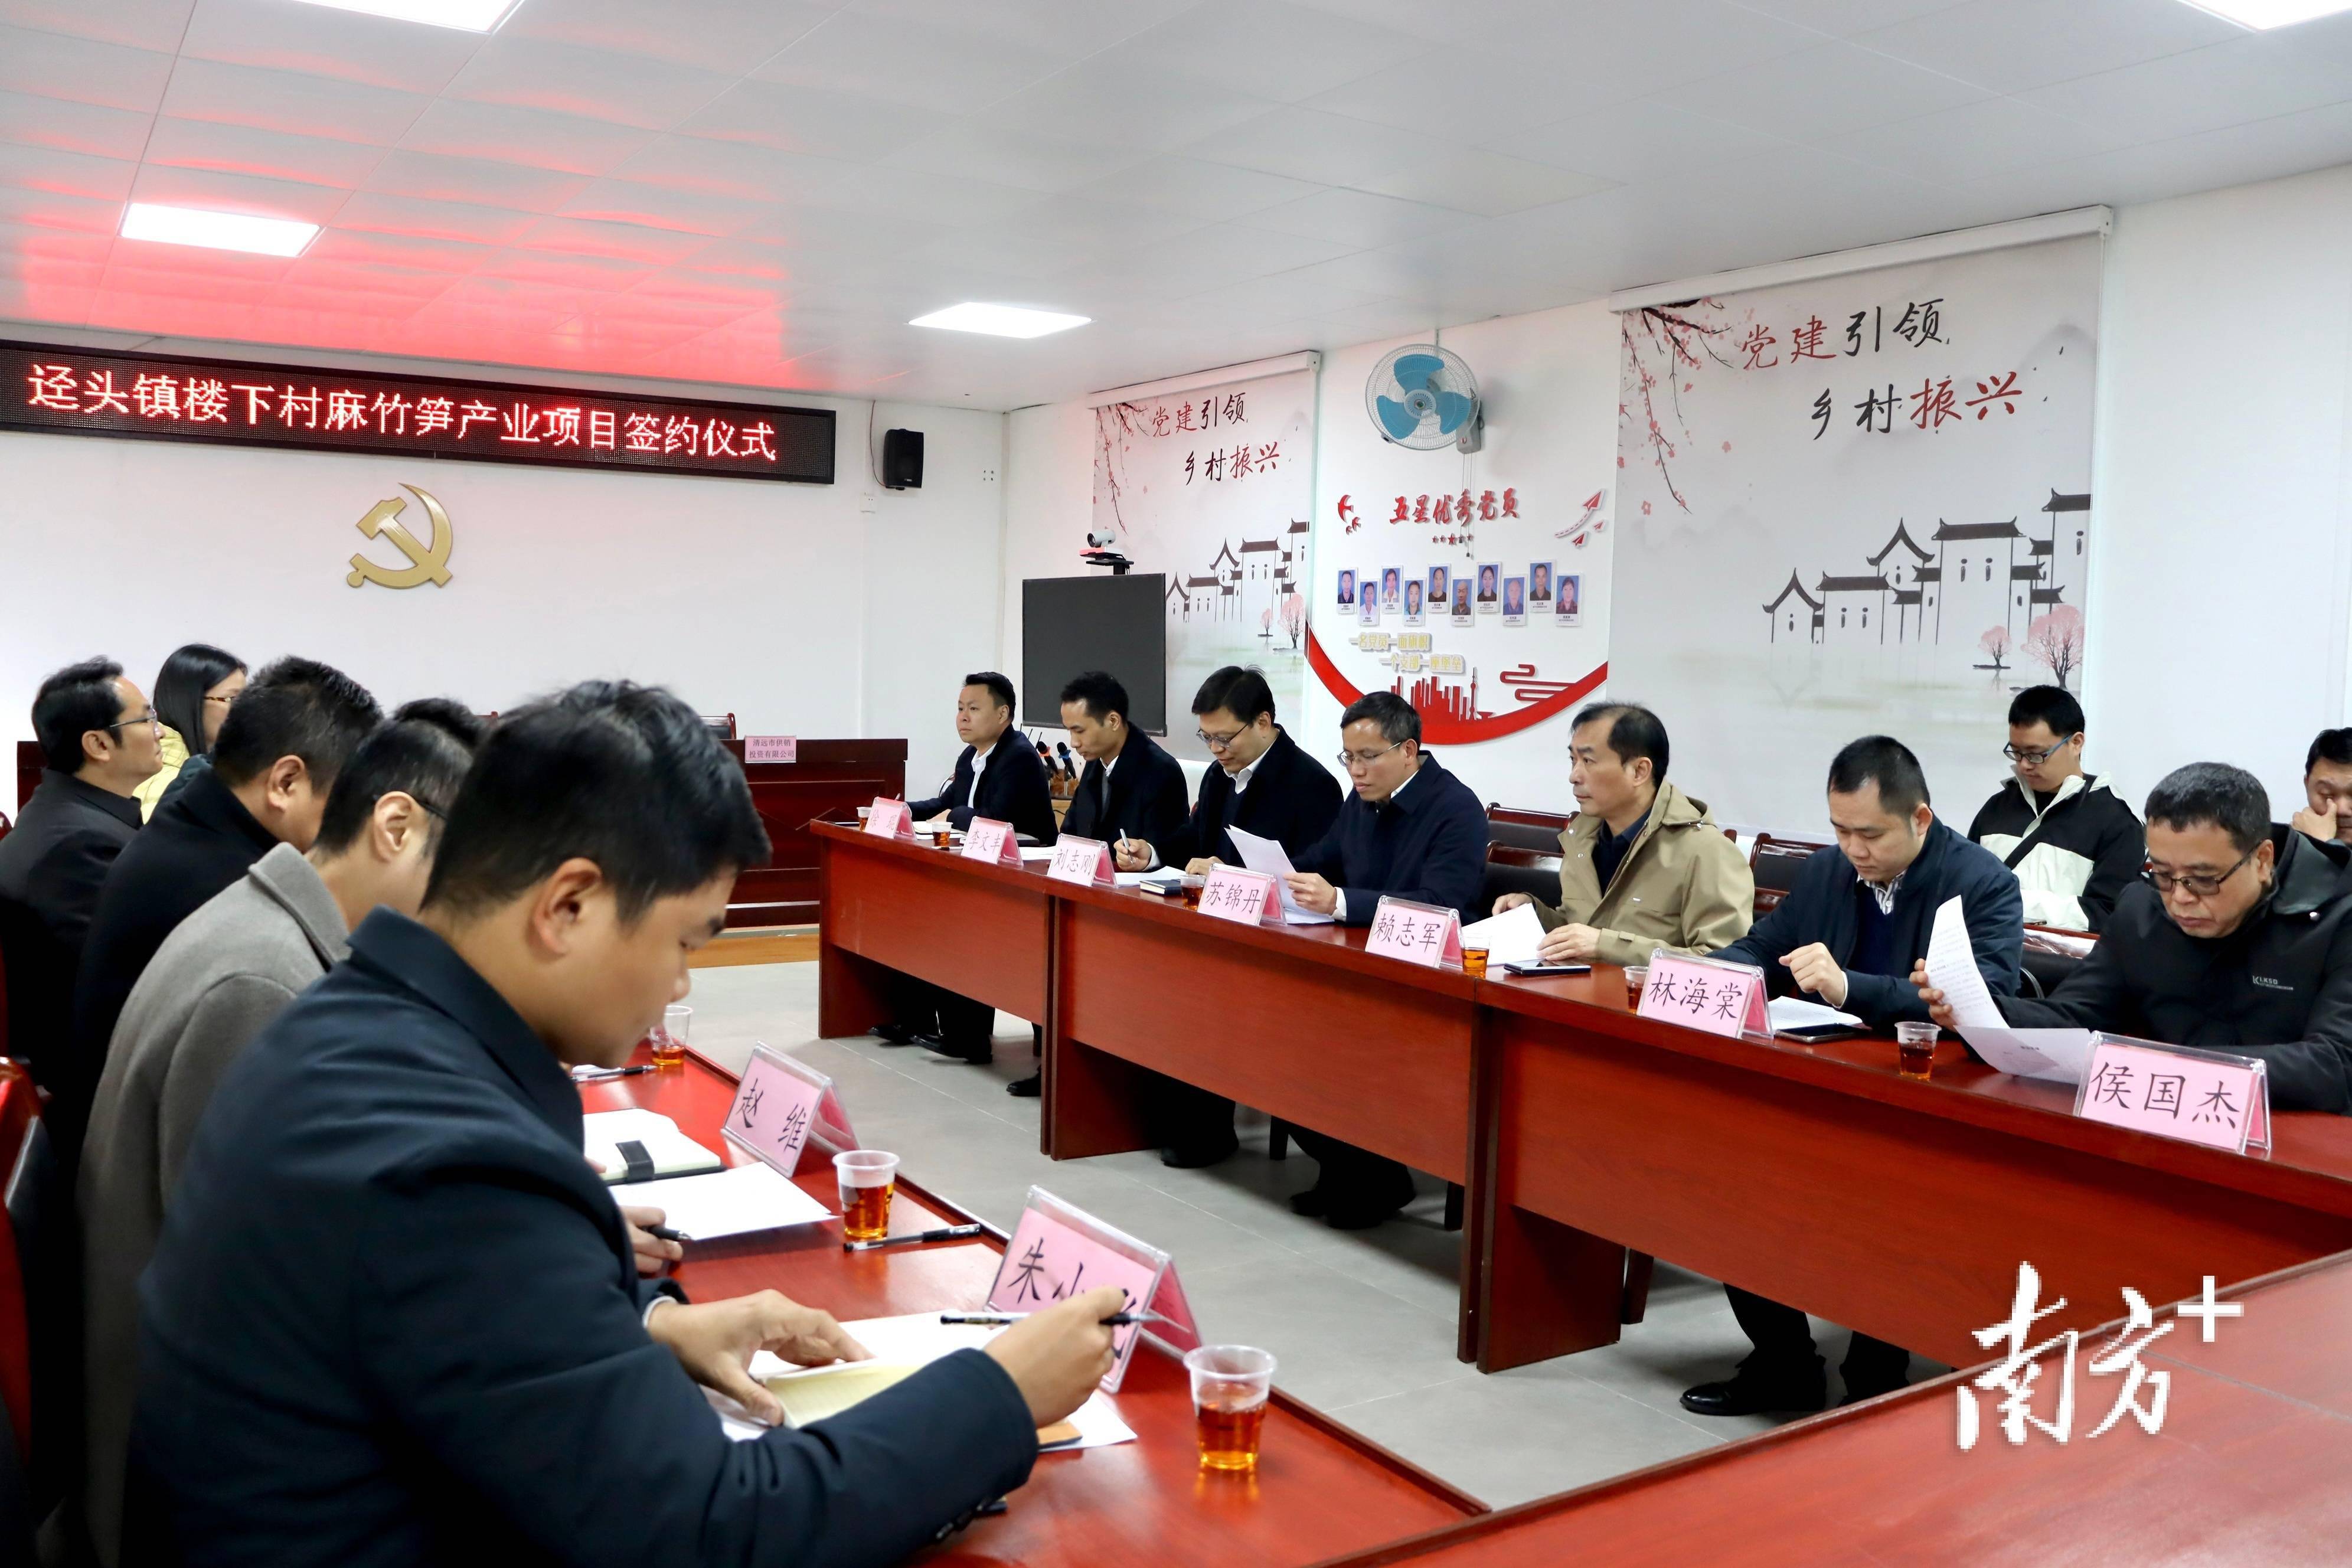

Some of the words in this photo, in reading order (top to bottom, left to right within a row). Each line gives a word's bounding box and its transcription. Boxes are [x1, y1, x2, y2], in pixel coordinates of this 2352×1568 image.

[1742, 298, 1945, 370] 党建引领
[27, 362, 777, 462] 迳头镇楼下村麻竹笋产业项目签约仪式
[1152, 391, 1248, 437] 党建引领
[1812, 371, 2023, 441] 乡村振兴
[1185, 440, 1280, 486] 乡村振兴
[1389, 487, 1521, 527] 五星优秀党员
[749, 749, 795, 759] 投资有限公司
[752, 738, 792, 747] 清远市供销
[968, 828, 1001, 854] 李文丰
[1053, 848, 1096, 877] 刘志刚
[1204, 880, 1262, 915] 苏锦丹
[1373, 912, 1442, 953] 赖志军
[1647, 971, 1743, 1021] 林海棠
[735, 1077, 806, 1153] 赵维
[2090, 1060, 2241, 1129] 侯国杰
